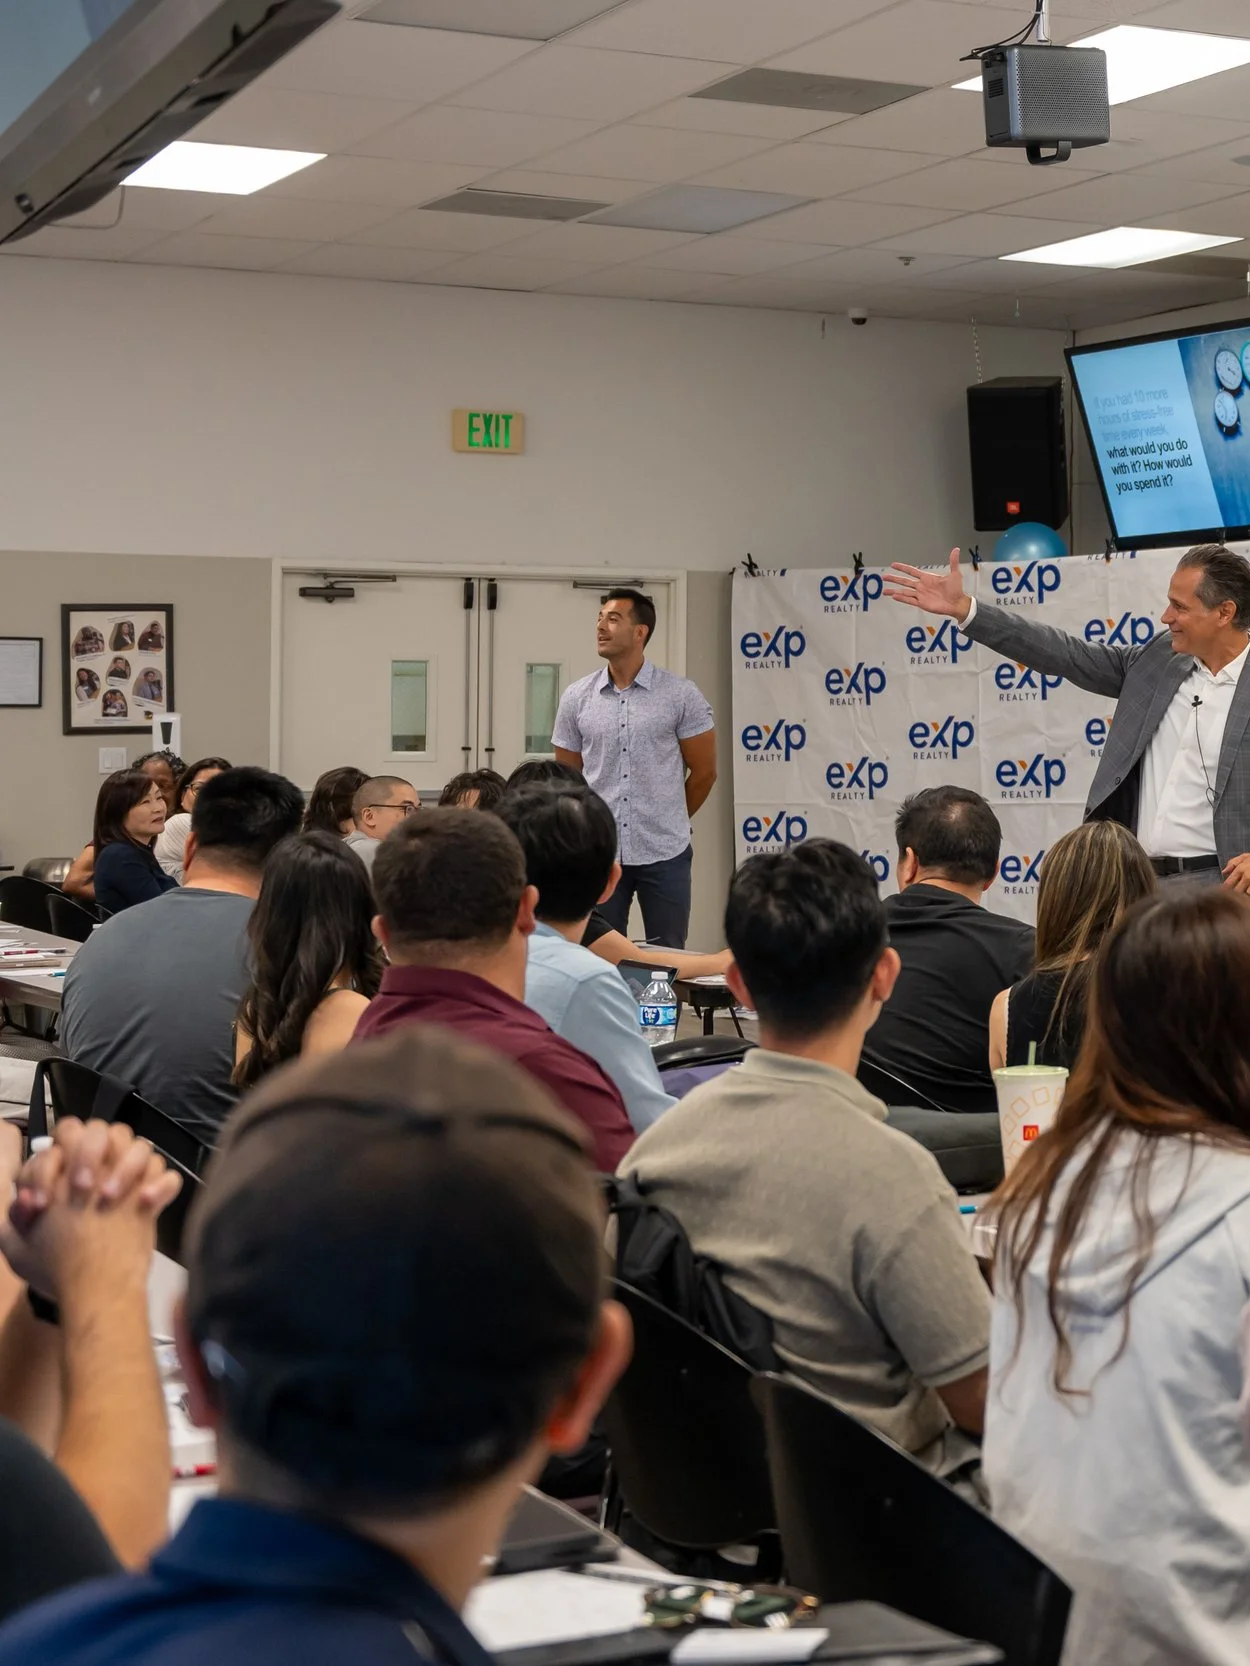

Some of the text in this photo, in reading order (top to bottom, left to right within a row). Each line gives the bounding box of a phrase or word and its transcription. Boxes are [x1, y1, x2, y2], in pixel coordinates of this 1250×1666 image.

[1134, 390, 1145, 403] 10
[468, 413, 513, 449] EXIT
[1107, 438, 1188, 459] what would you do
[1111, 454, 1193, 476] with it? How would
[1116, 474, 1174, 495] you spend it?
[997, 596, 1035, 605] REALTY
[824, 604, 861, 613] REALTY
[745, 661, 782, 669] REALTY
[911, 656, 947, 665] REALTY
[999, 692, 1037, 701] REALTY
[829, 698, 863, 706] REALTY
[746, 754, 782, 762] REALTY
[913, 752, 949, 760] REALTY
[831, 792, 865, 800] REALTY
[1001, 790, 1042, 799] REALTY
[746, 845, 782, 853] REALTY
[1001, 851, 1045, 882] eX
[1004, 886, 1037, 894] REALT
